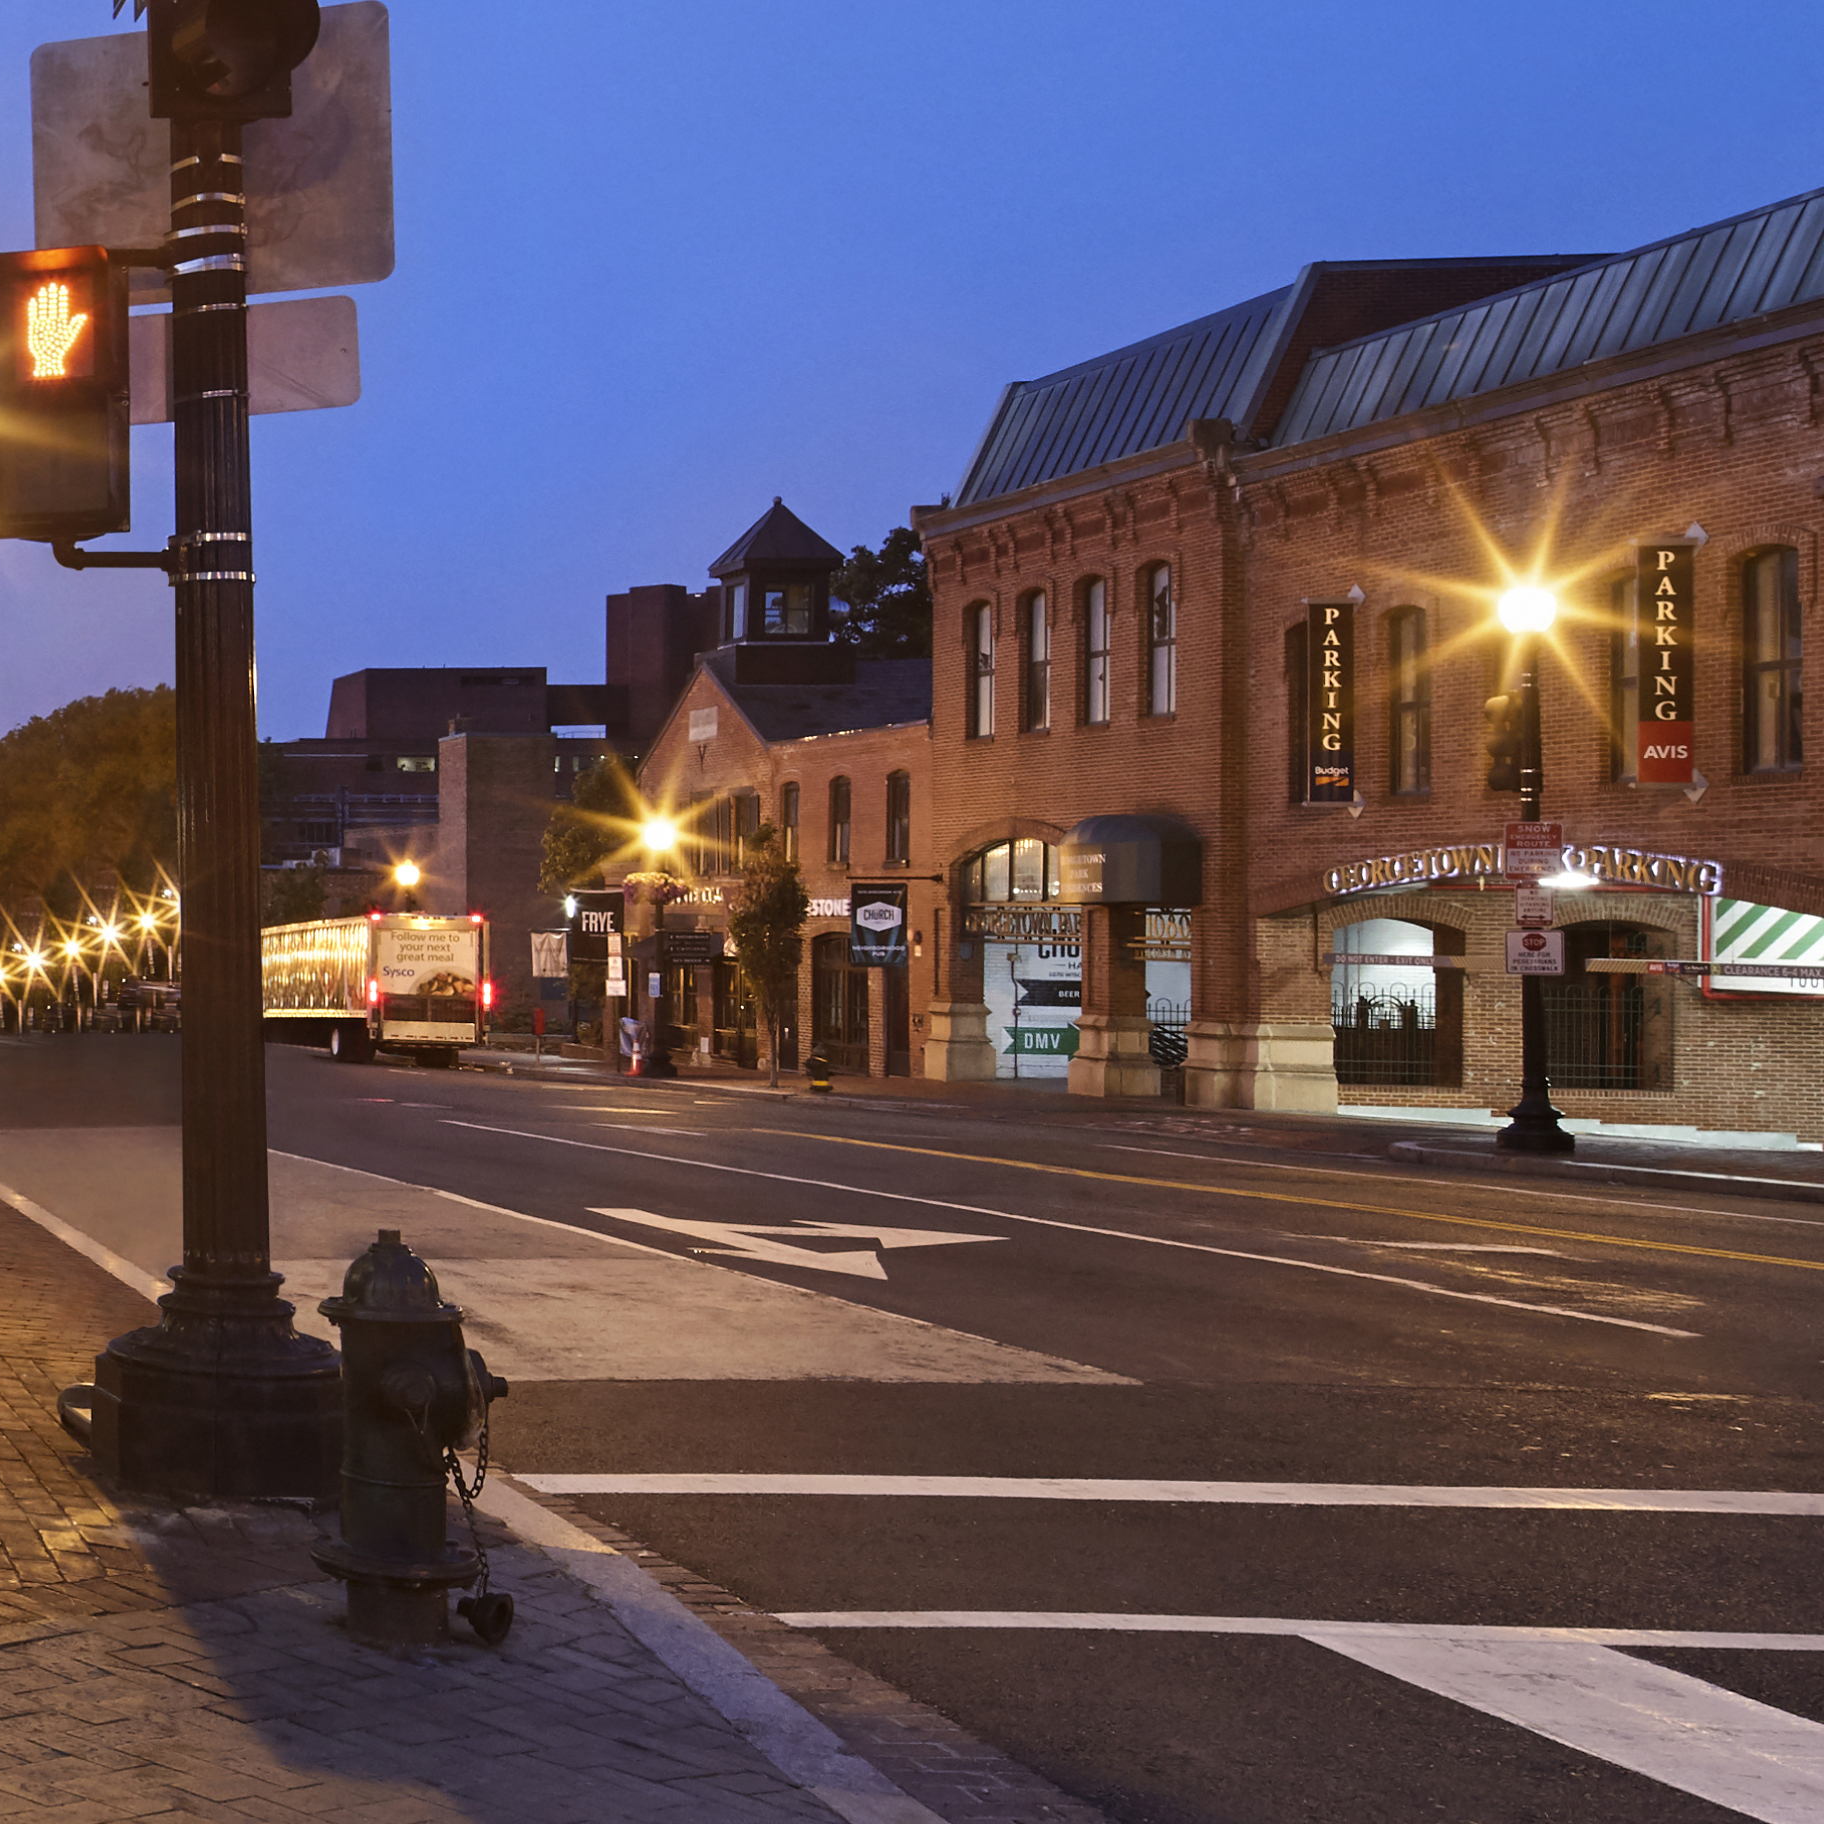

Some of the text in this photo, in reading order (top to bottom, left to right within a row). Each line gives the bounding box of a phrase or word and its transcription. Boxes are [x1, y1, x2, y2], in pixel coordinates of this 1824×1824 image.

[1655, 551, 1678, 721] PARKING
[1322, 608, 1342, 751] PARKING
[1643, 745, 1688, 759] AVIS
[1315, 766, 1349, 776] Budget
[1517, 825, 1551, 833] SNOW
[1323, 844, 1500, 893] GEORGETOWN
[1583, 848, 1718, 894] PARKING
[863, 909, 895, 921] CHURCH
[582, 911, 615, 933] FRYE
[391, 932, 461, 943] Follow me to
[1523, 938, 1545, 946] STOP
[399, 943, 451, 953] your next
[396, 953, 455, 964] great meal
[1335, 954, 1345, 964] DO
[1347, 955, 1363, 964] NOT
[1365, 955, 1388, 964] ENTER
[1395, 956, 1414, 964] EXIT
[1415, 956, 1435, 965] ONLY
[383, 965, 415, 978] Sysco
[1649, 963, 1663, 971] AVIS
[1724, 965, 1780, 976] CLEARANCE
[1058, 989, 1080, 999] BEER
[1024, 1033, 1061, 1050] DMV
